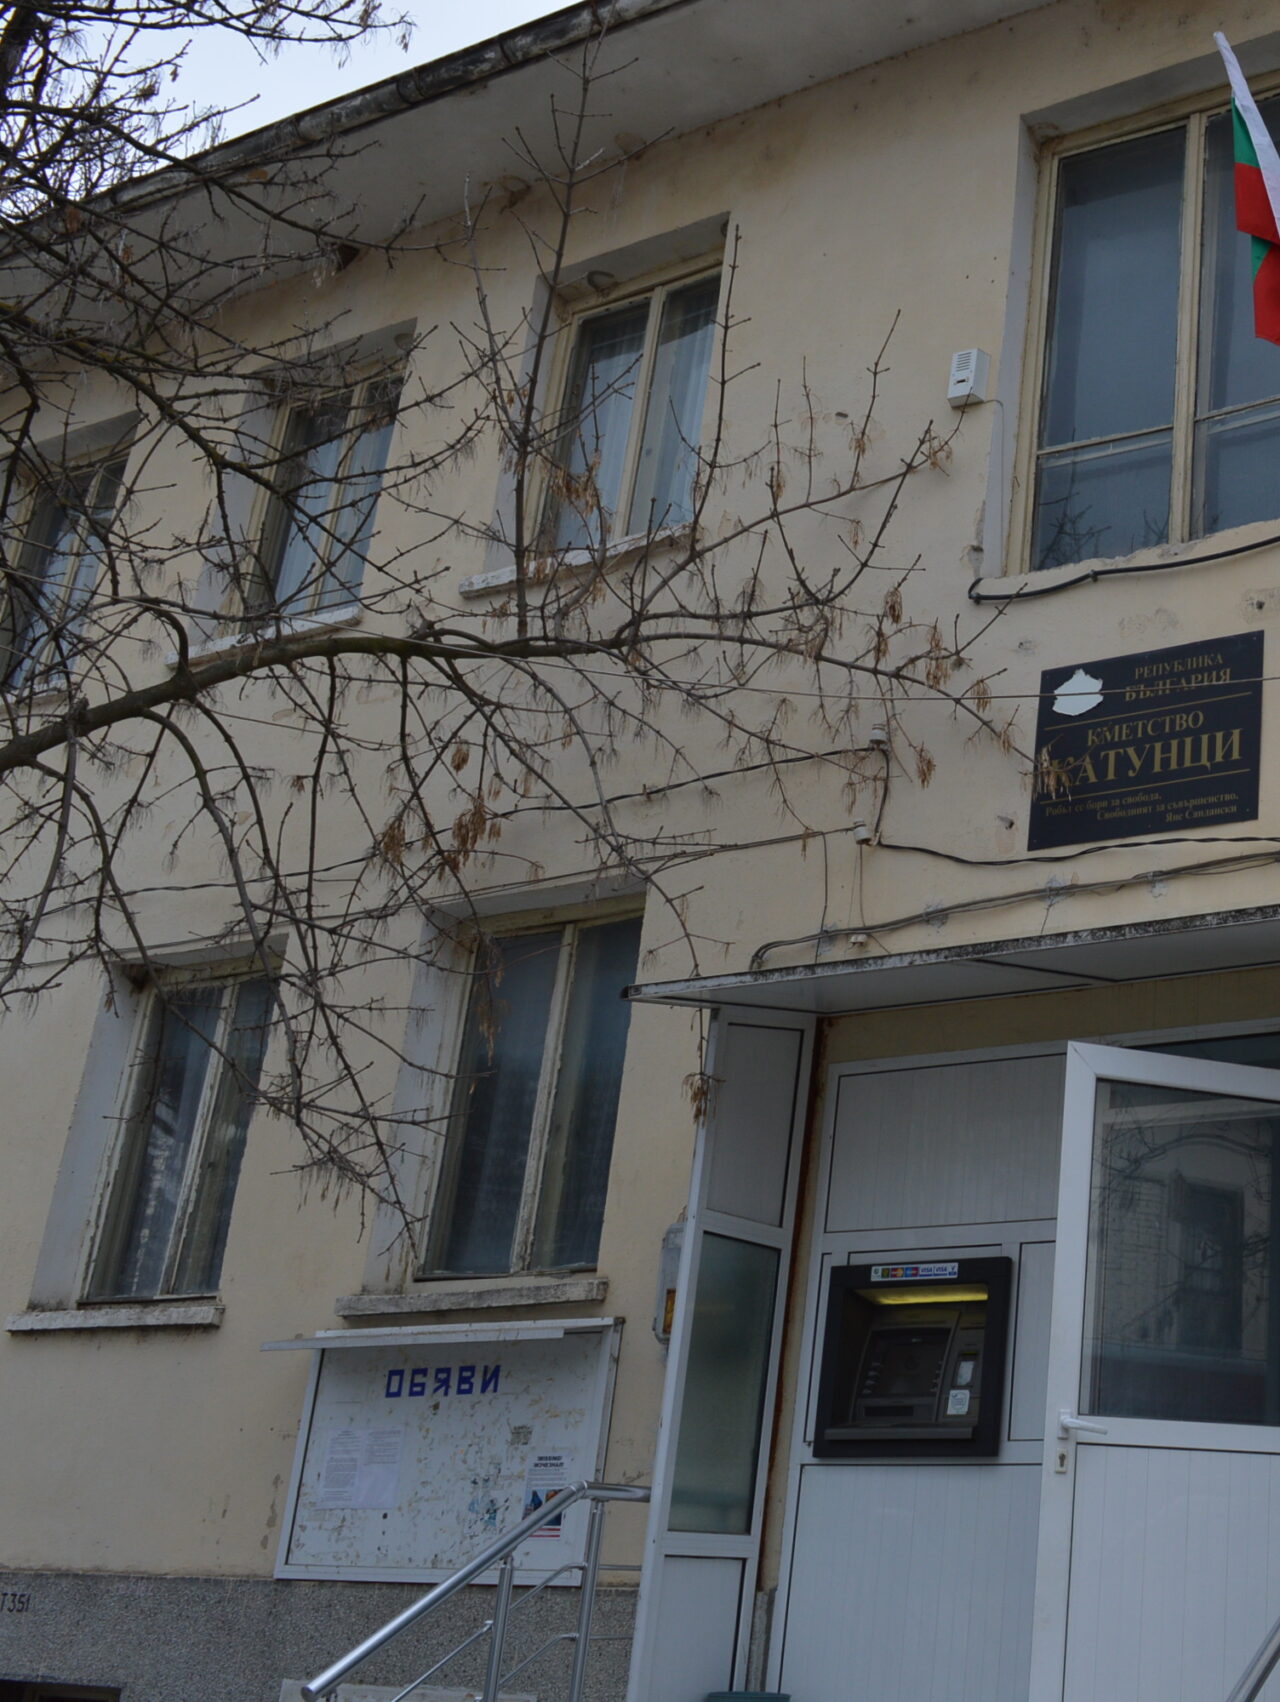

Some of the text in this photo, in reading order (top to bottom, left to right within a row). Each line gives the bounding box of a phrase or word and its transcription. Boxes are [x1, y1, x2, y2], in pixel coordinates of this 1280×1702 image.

[1134, 653, 1224, 680] РЕПУБЛИКА
[1125, 668, 1231, 701] БЪЛГАРИЯ
[1087, 711, 1204, 746] КМЕТСТВО
[385, 1364, 501, 1398] ОБЯВИ
